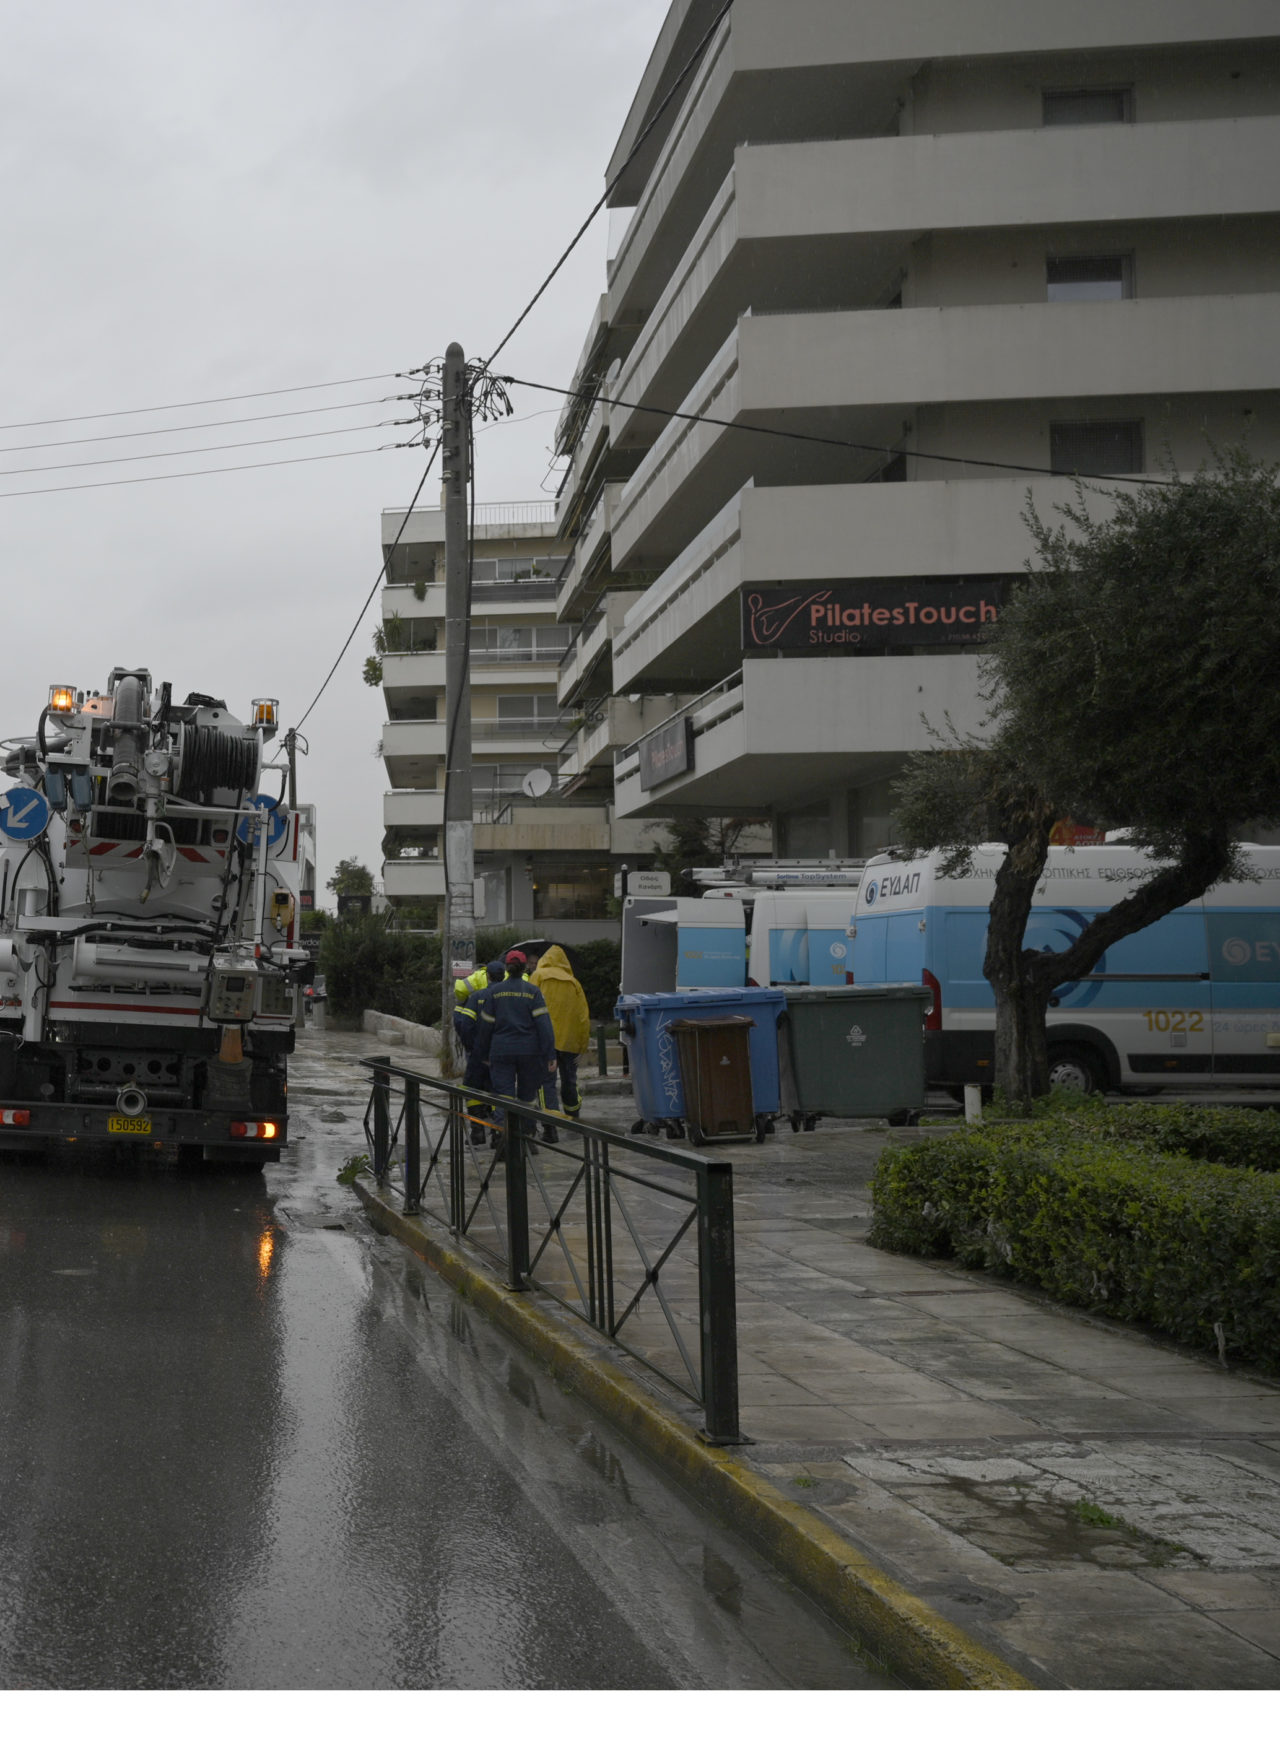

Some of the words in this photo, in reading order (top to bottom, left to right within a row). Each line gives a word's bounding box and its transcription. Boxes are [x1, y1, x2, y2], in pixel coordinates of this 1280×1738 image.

[809, 630, 861, 644] Studio
[800, 873, 847, 881] TopSystem
[880, 872, 921, 898] ΕΥΔΑΠ
[1143, 1011, 1204, 1032] 1022
[111, 1118, 149, 1131] 150592
